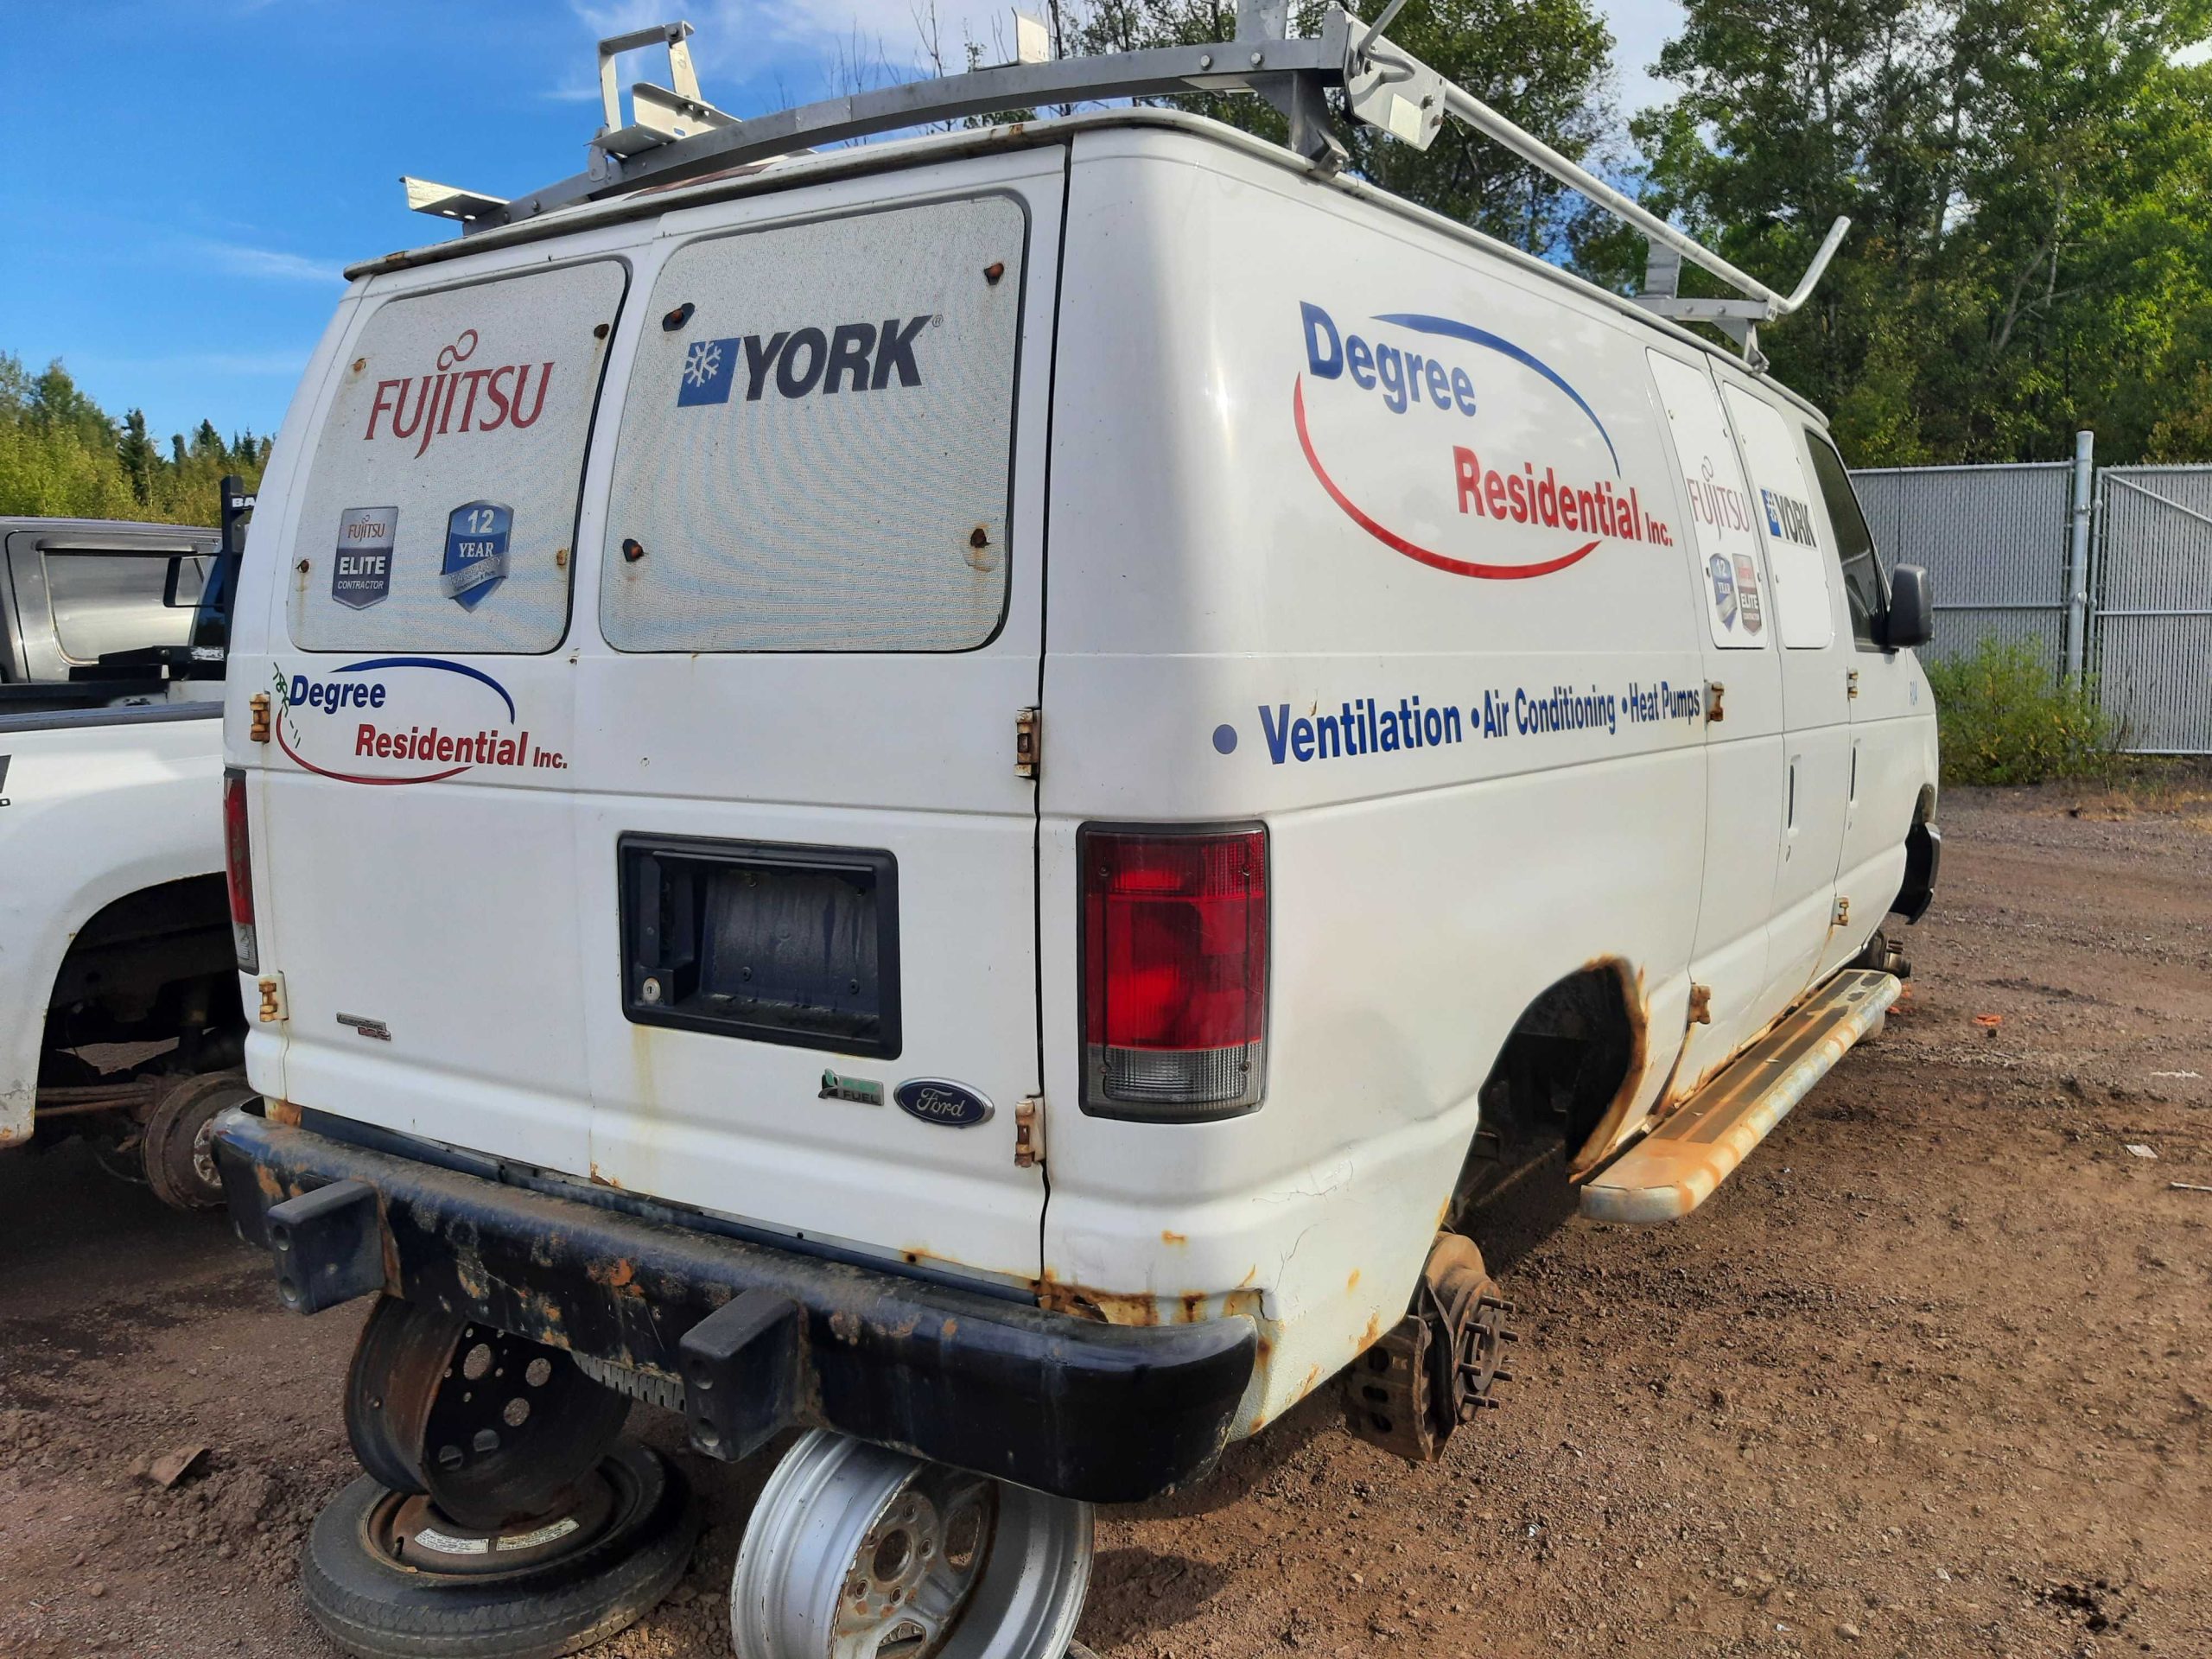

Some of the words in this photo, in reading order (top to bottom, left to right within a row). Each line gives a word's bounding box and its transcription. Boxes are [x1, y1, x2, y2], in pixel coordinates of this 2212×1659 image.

[1299, 300, 1477, 416] Degree
[364, 361, 556, 460] FUJITSU
[1452, 445, 1642, 542] Residential
[1645, 512, 1674, 547] Inc.
[1686, 477, 1751, 541] FUJITSU
[347, 522, 385, 543] FUJITSU
[467, 509, 495, 534] 12
[1773, 493, 1817, 548] YORK
[338, 556, 386, 575] ELITE
[459, 542, 494, 558] YEAR
[337, 580, 385, 590] CONTRACTOR
[1740, 593, 1759, 610] ELITE
[289, 674, 386, 715] Degree
[1257, 695, 1463, 766] Ventilation
[1515, 683, 1616, 736] Conditioning
[1661, 680, 1700, 725] Pumps
[355, 722, 530, 767] Residential
[533, 746, 569, 770] Inc.
[916, 1086, 966, 1117] Ford
